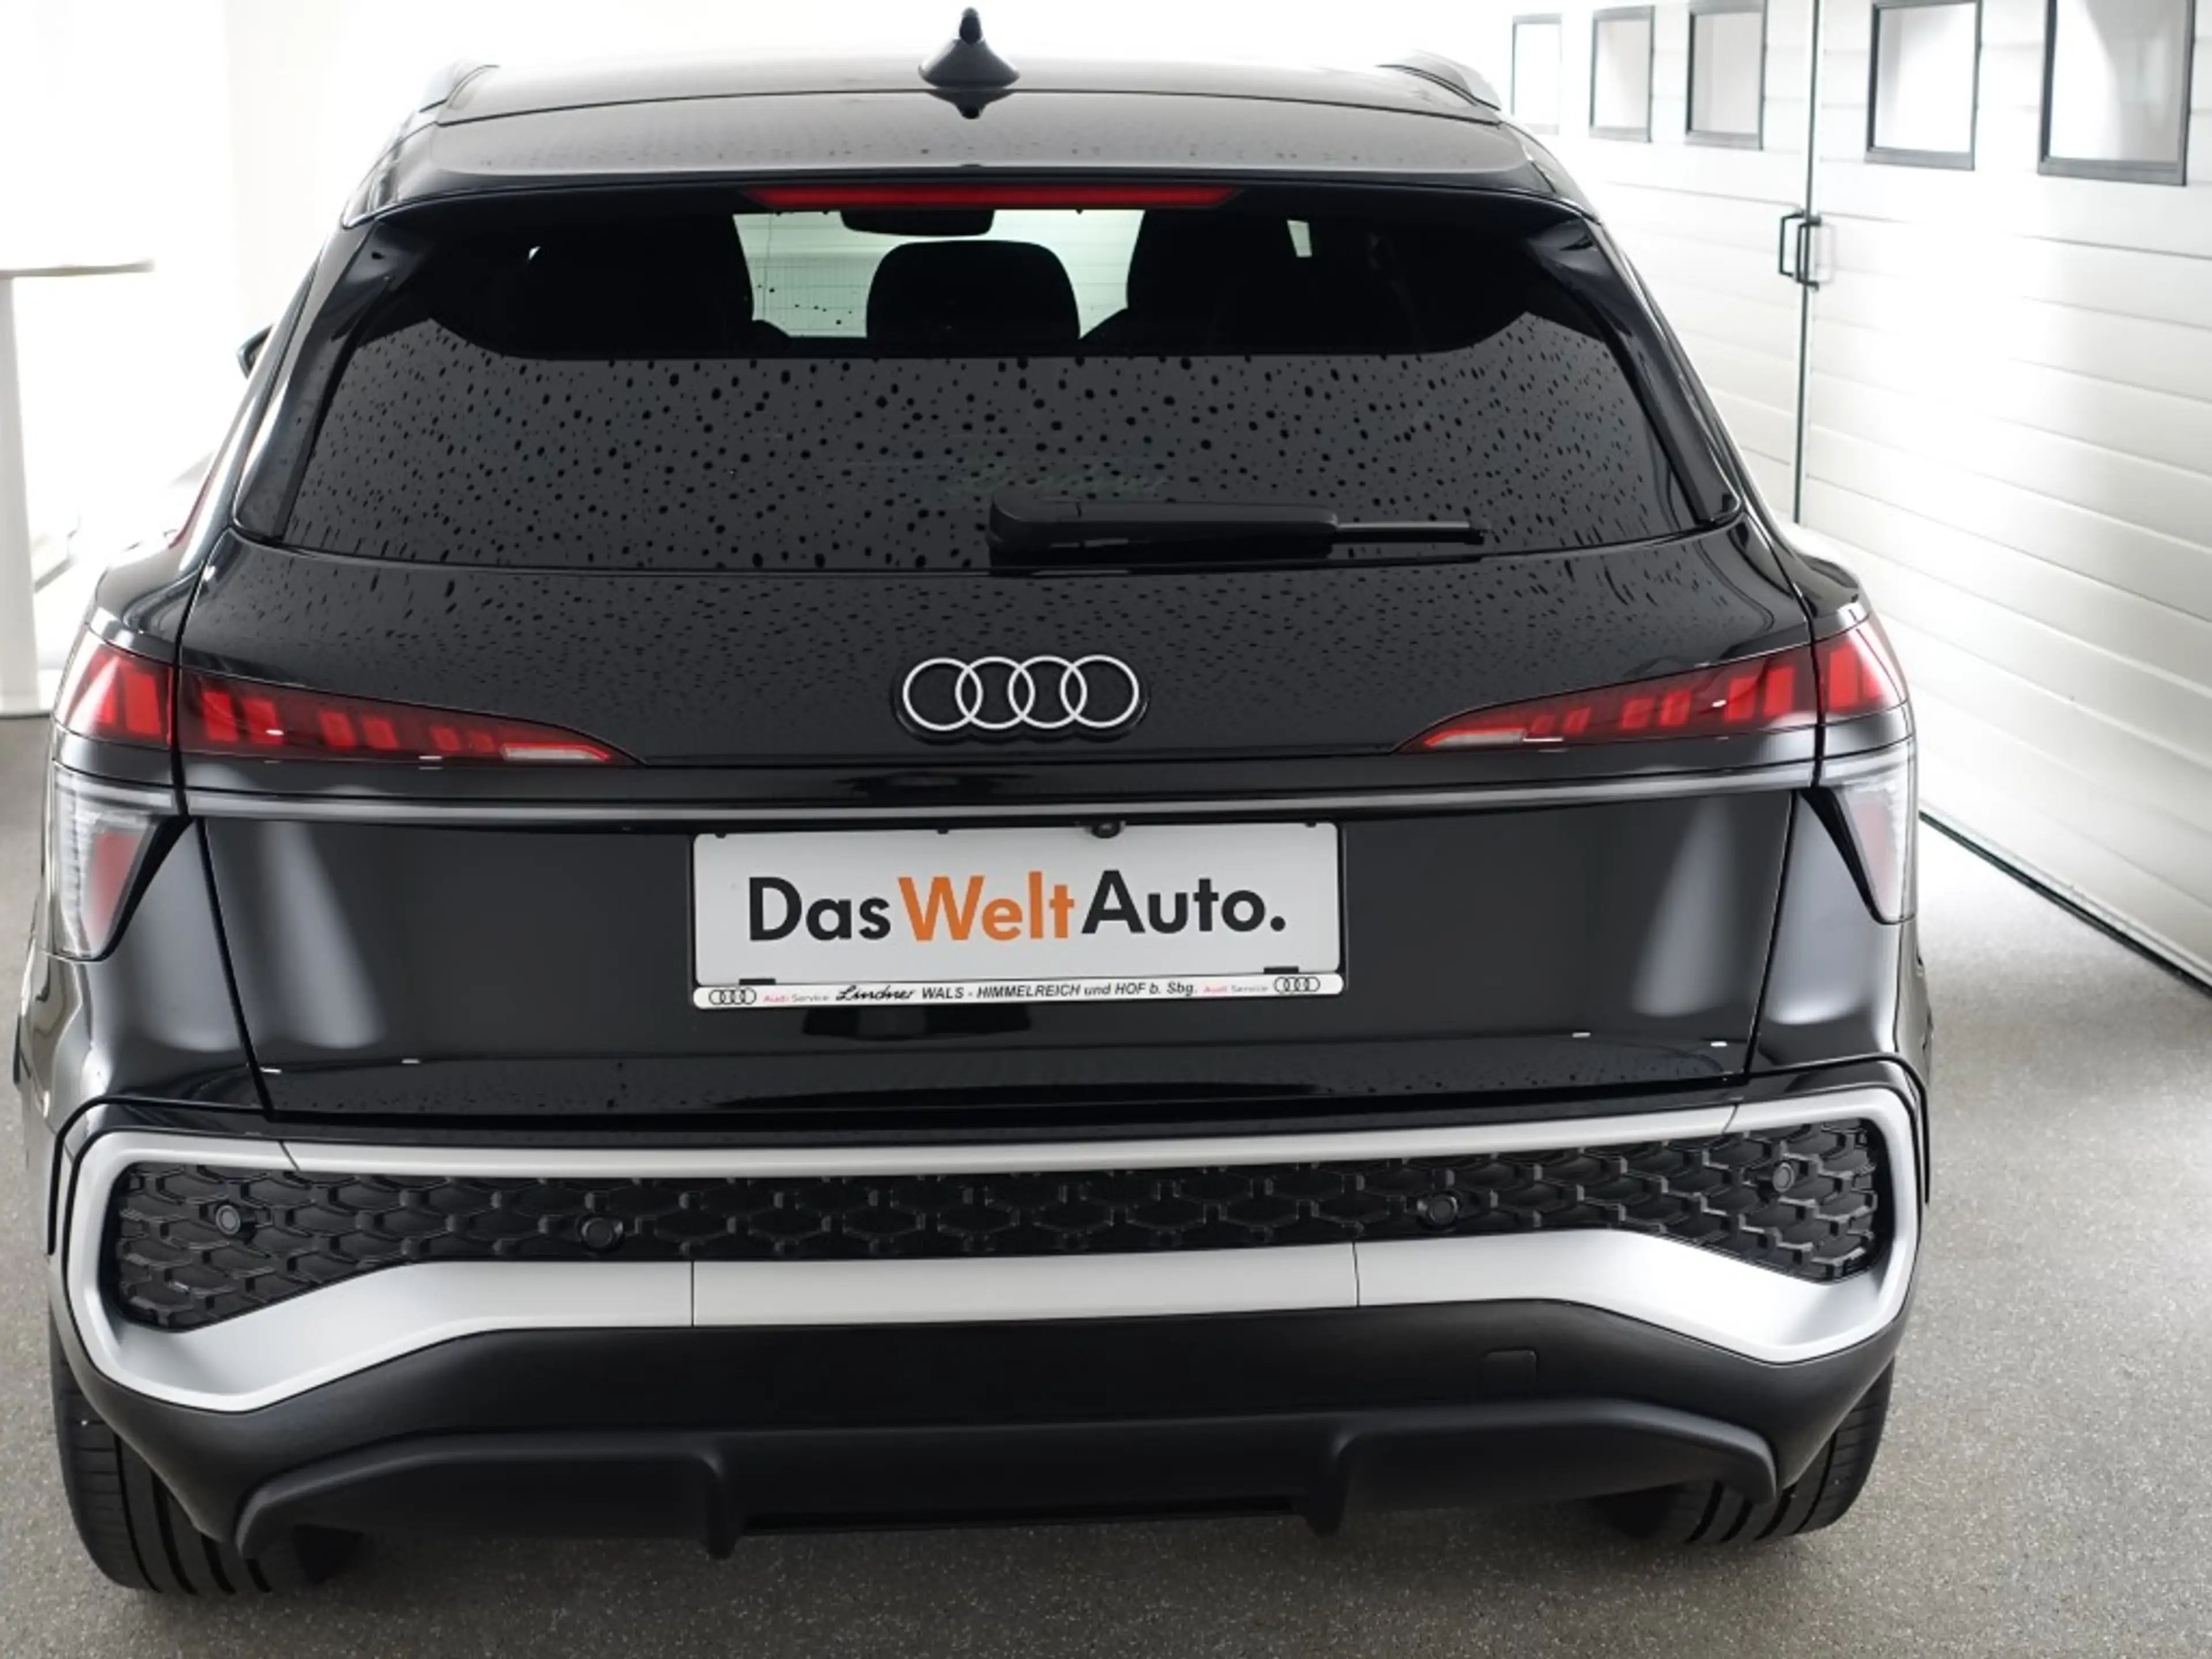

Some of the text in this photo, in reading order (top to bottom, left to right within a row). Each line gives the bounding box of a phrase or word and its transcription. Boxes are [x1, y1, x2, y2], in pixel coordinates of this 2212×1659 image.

[835, 984, 915, 1001] Lindner
[922, 987, 964, 999] WALS
[976, 984, 1080, 998] HIMMELREICH
[1084, 983, 1111, 995] und
[1115, 983, 1146, 995] HOF
[1149, 982, 1161, 995] b.
[1166, 981, 1197, 997] Sbg.
